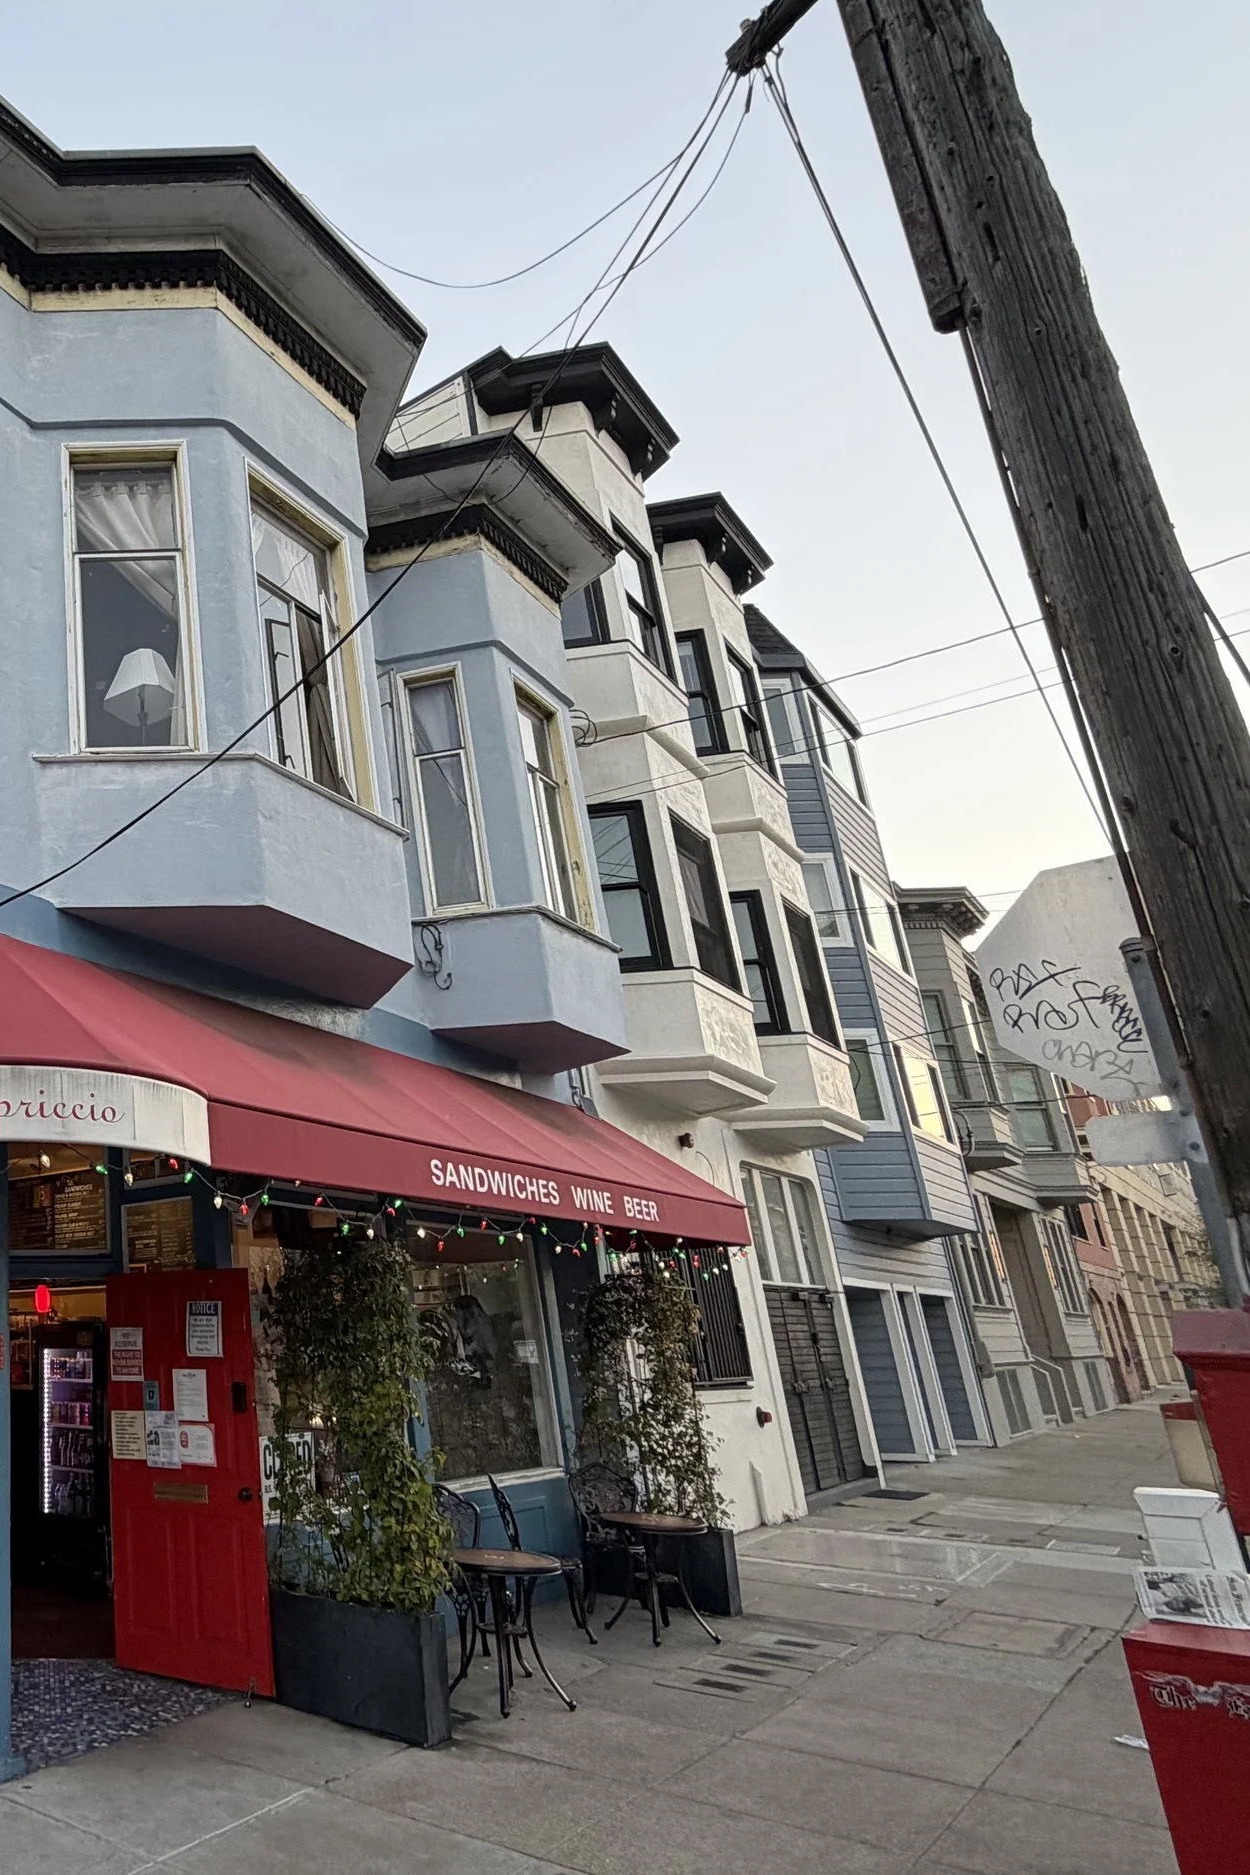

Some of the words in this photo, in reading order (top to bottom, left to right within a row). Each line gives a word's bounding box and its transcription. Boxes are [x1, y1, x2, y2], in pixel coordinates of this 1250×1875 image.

[431, 1159, 560, 1206] SANDWICHES
[571, 1185, 614, 1215] WINE
[624, 1195, 659, 1223] BEER
[191, 1303, 215, 1314] NOTICE
[1149, 1683, 1198, 1711] The
